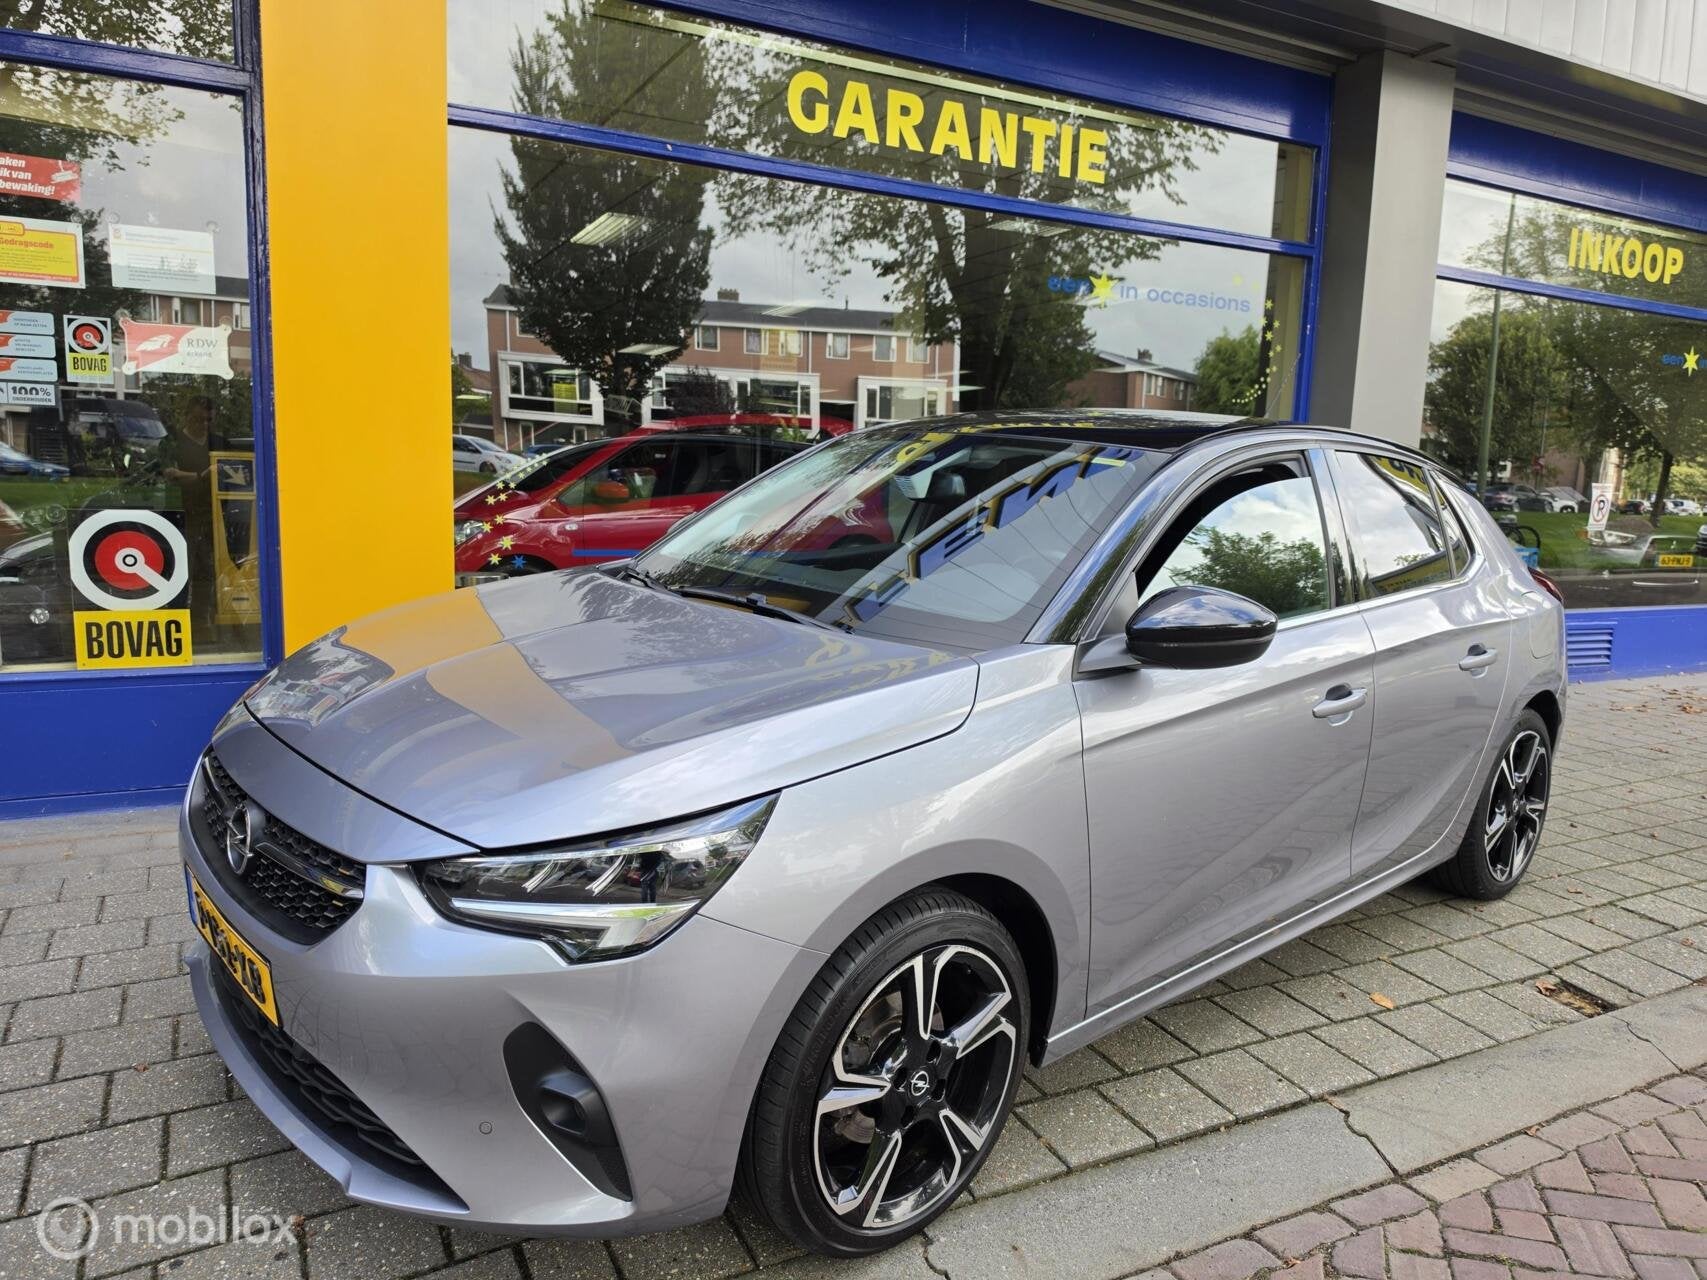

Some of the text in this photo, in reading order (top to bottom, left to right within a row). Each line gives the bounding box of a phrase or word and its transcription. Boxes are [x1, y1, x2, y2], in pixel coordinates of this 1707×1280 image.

[787, 70, 1109, 184] GARANTIE
[12, 170, 32, 181] van
[0, 178, 55, 196] bewaking!
[1568, 227, 1684, 285] INKOOP
[1120, 284, 1138, 300] in
[1147, 287, 1251, 313] occasions
[186, 337, 218, 350] RDW
[73, 356, 107, 372] BOVAG
[11, 386, 51, 397] 100%
[85, 619, 183, 659] BOVAG
